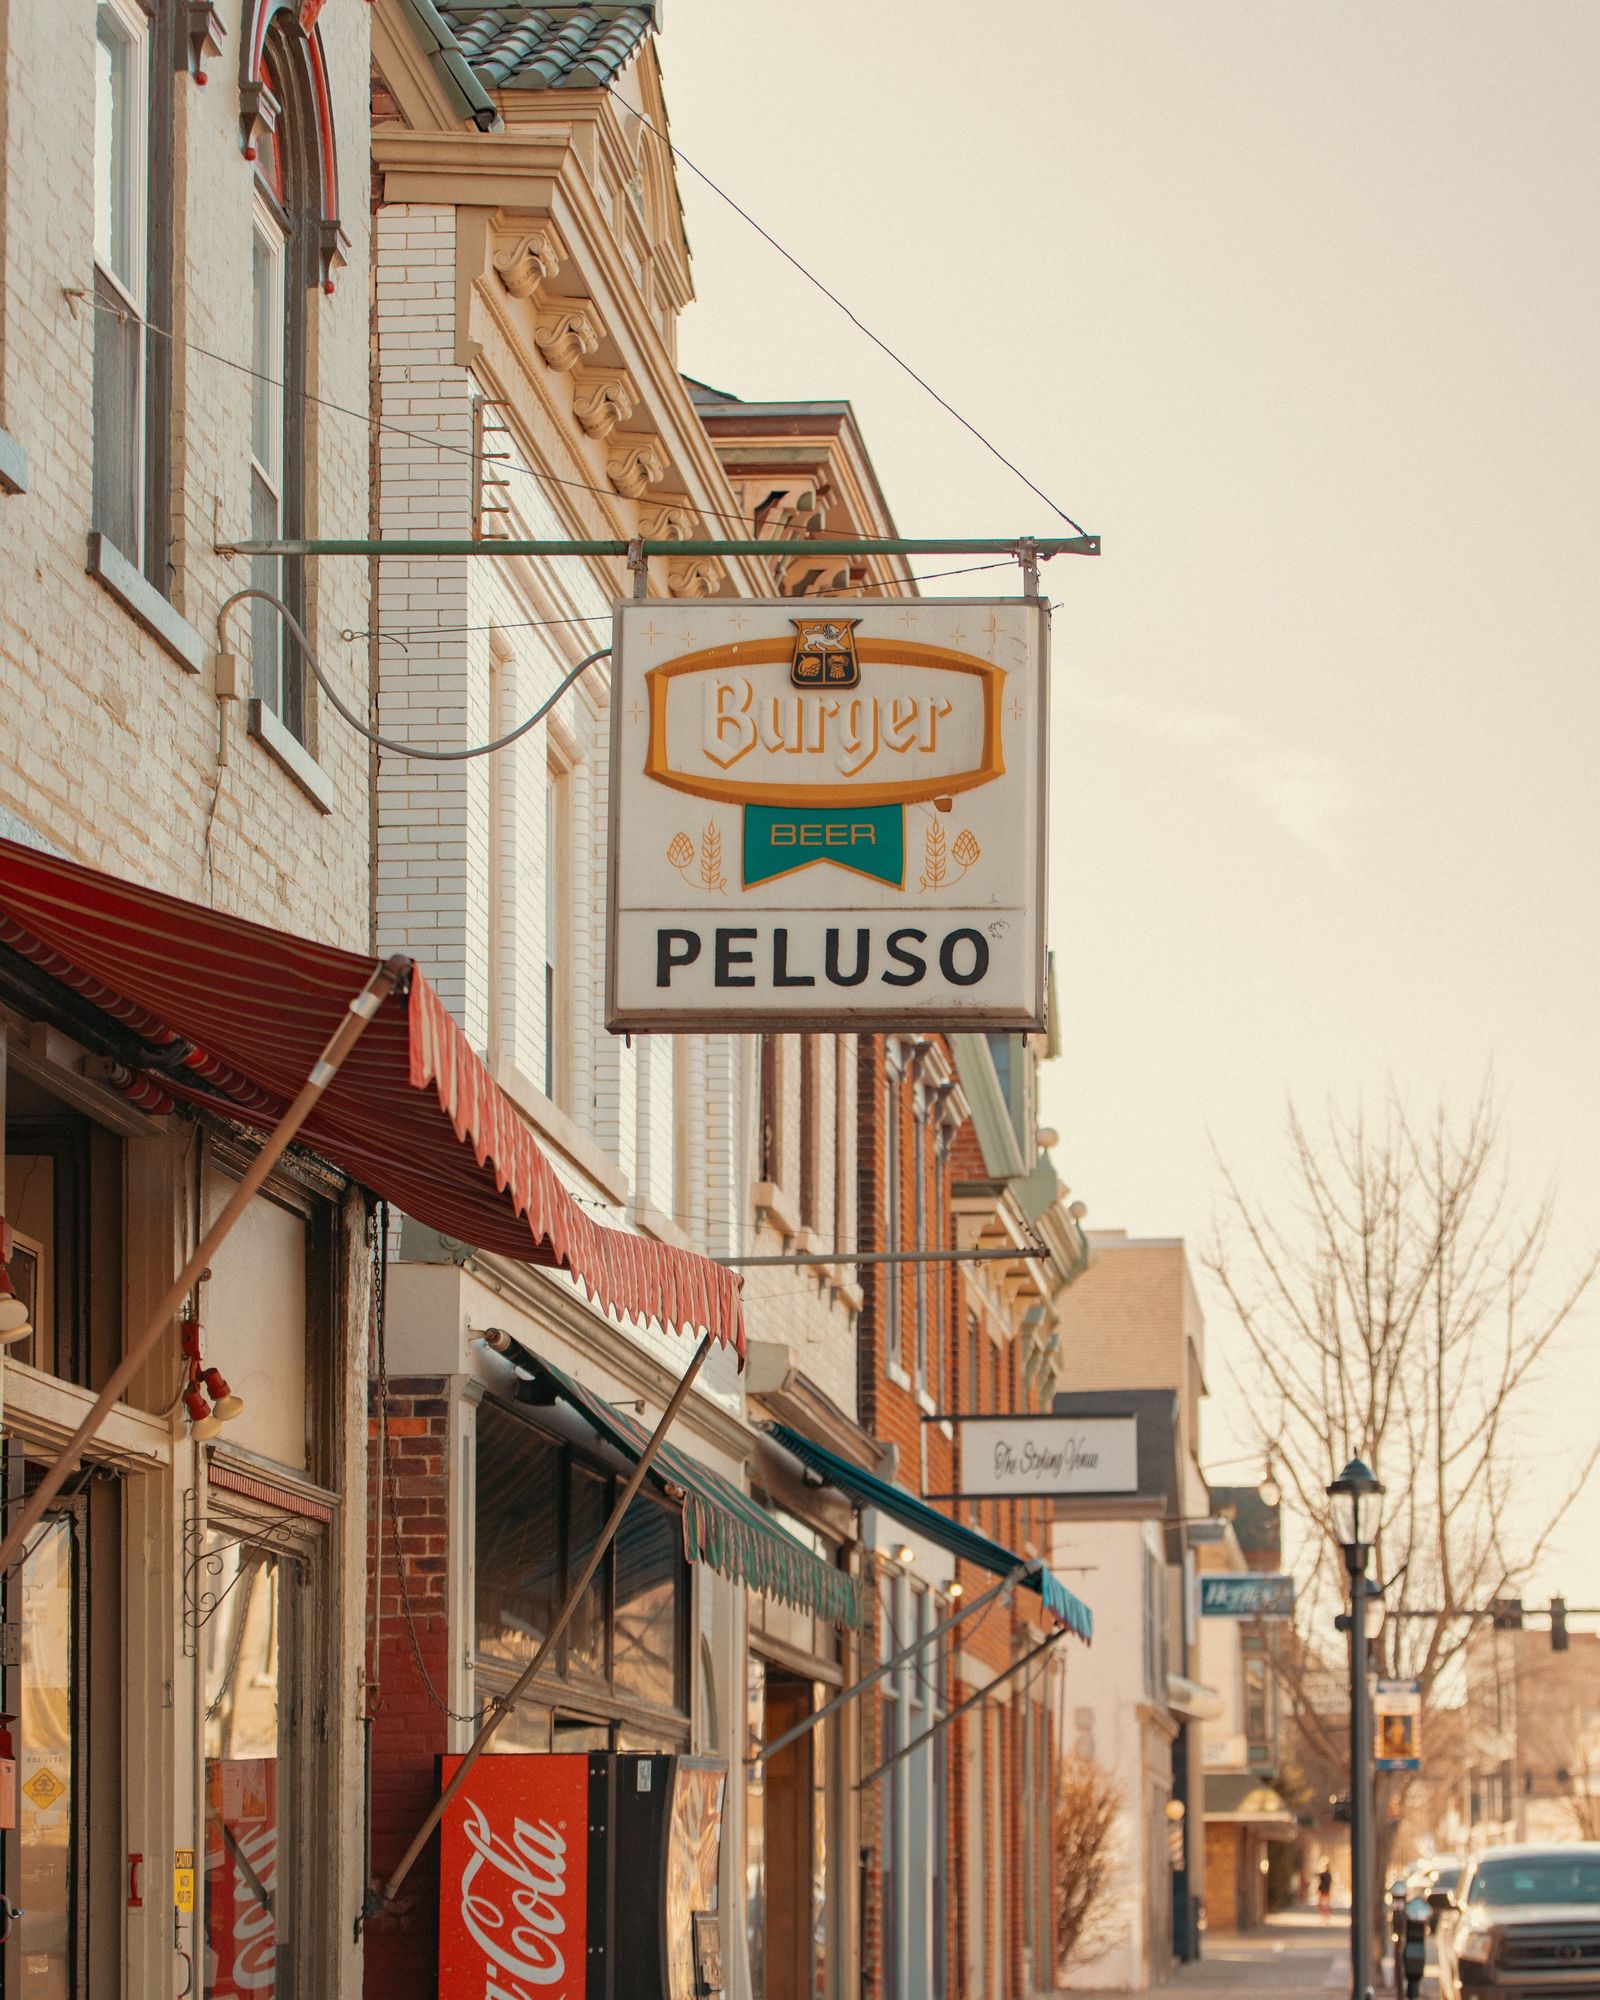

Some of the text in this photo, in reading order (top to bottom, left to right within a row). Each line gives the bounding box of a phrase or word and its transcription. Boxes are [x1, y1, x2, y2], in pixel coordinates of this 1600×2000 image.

[702, 678, 953, 778] Burger
[770, 823, 876, 846] BEER
[656, 928, 990, 987] PELUSO
[993, 1440, 1018, 1480] The
[1020, 1440, 1063, 1479] Styling
